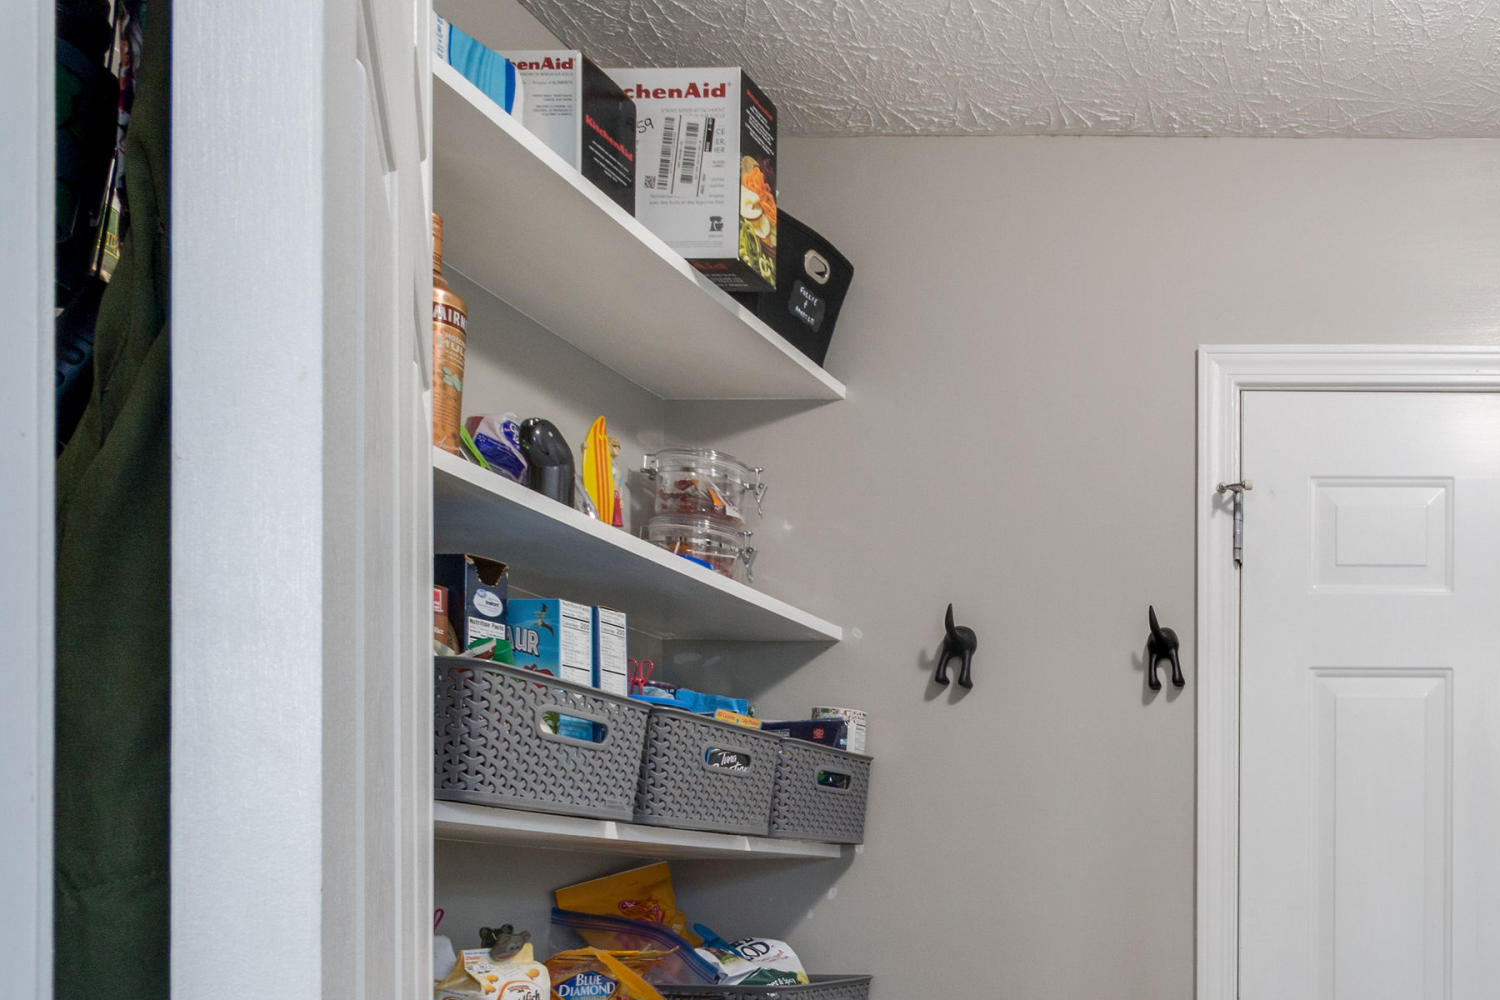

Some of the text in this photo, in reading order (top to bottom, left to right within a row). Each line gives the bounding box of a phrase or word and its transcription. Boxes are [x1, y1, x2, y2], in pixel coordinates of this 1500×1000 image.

[508, 57, 574, 71] enAid
[624, 82, 726, 99] chenAid
[505, 624, 540, 657] AUR
[576, 974, 603, 986] BLUE
[559, 981, 616, 997] DIAMOND
